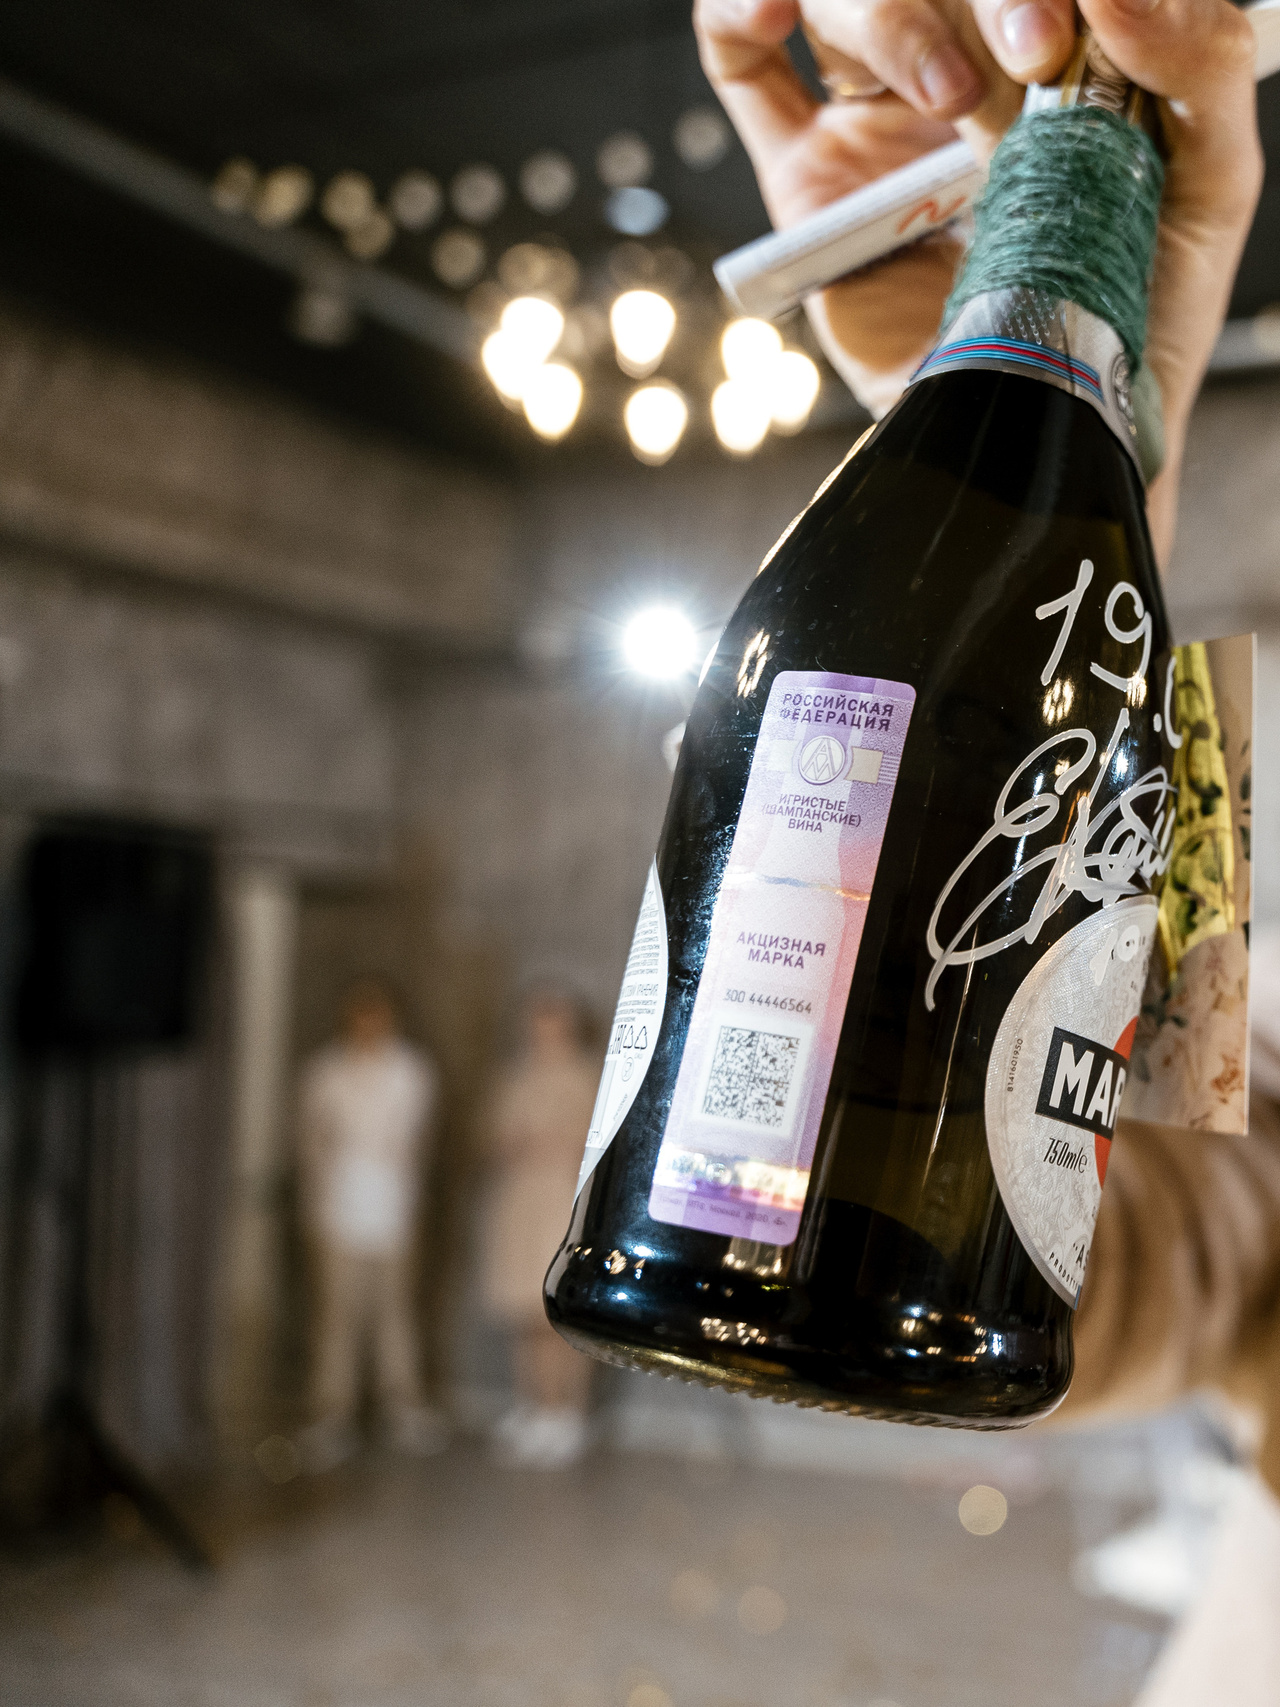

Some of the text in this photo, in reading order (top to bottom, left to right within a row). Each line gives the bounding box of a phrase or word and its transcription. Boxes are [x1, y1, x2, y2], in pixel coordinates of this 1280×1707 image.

[783, 693, 895, 717] РОССИЙСКАЯ
[780, 709, 891, 731] ФЕДЕРАЦИЯ
[778, 793, 847, 812] ИГРИСТЫЕ
[762, 803, 862, 827] (ШАМПАНСКИЕ)
[788, 818, 823, 833] ВИНА
[736, 931, 826, 957] АКЦИЗНАЯ
[747, 948, 805, 969] МАРКА
[749, 992, 812, 1014] 44446564
[1006, 1038, 1024, 1092] 8141601950
